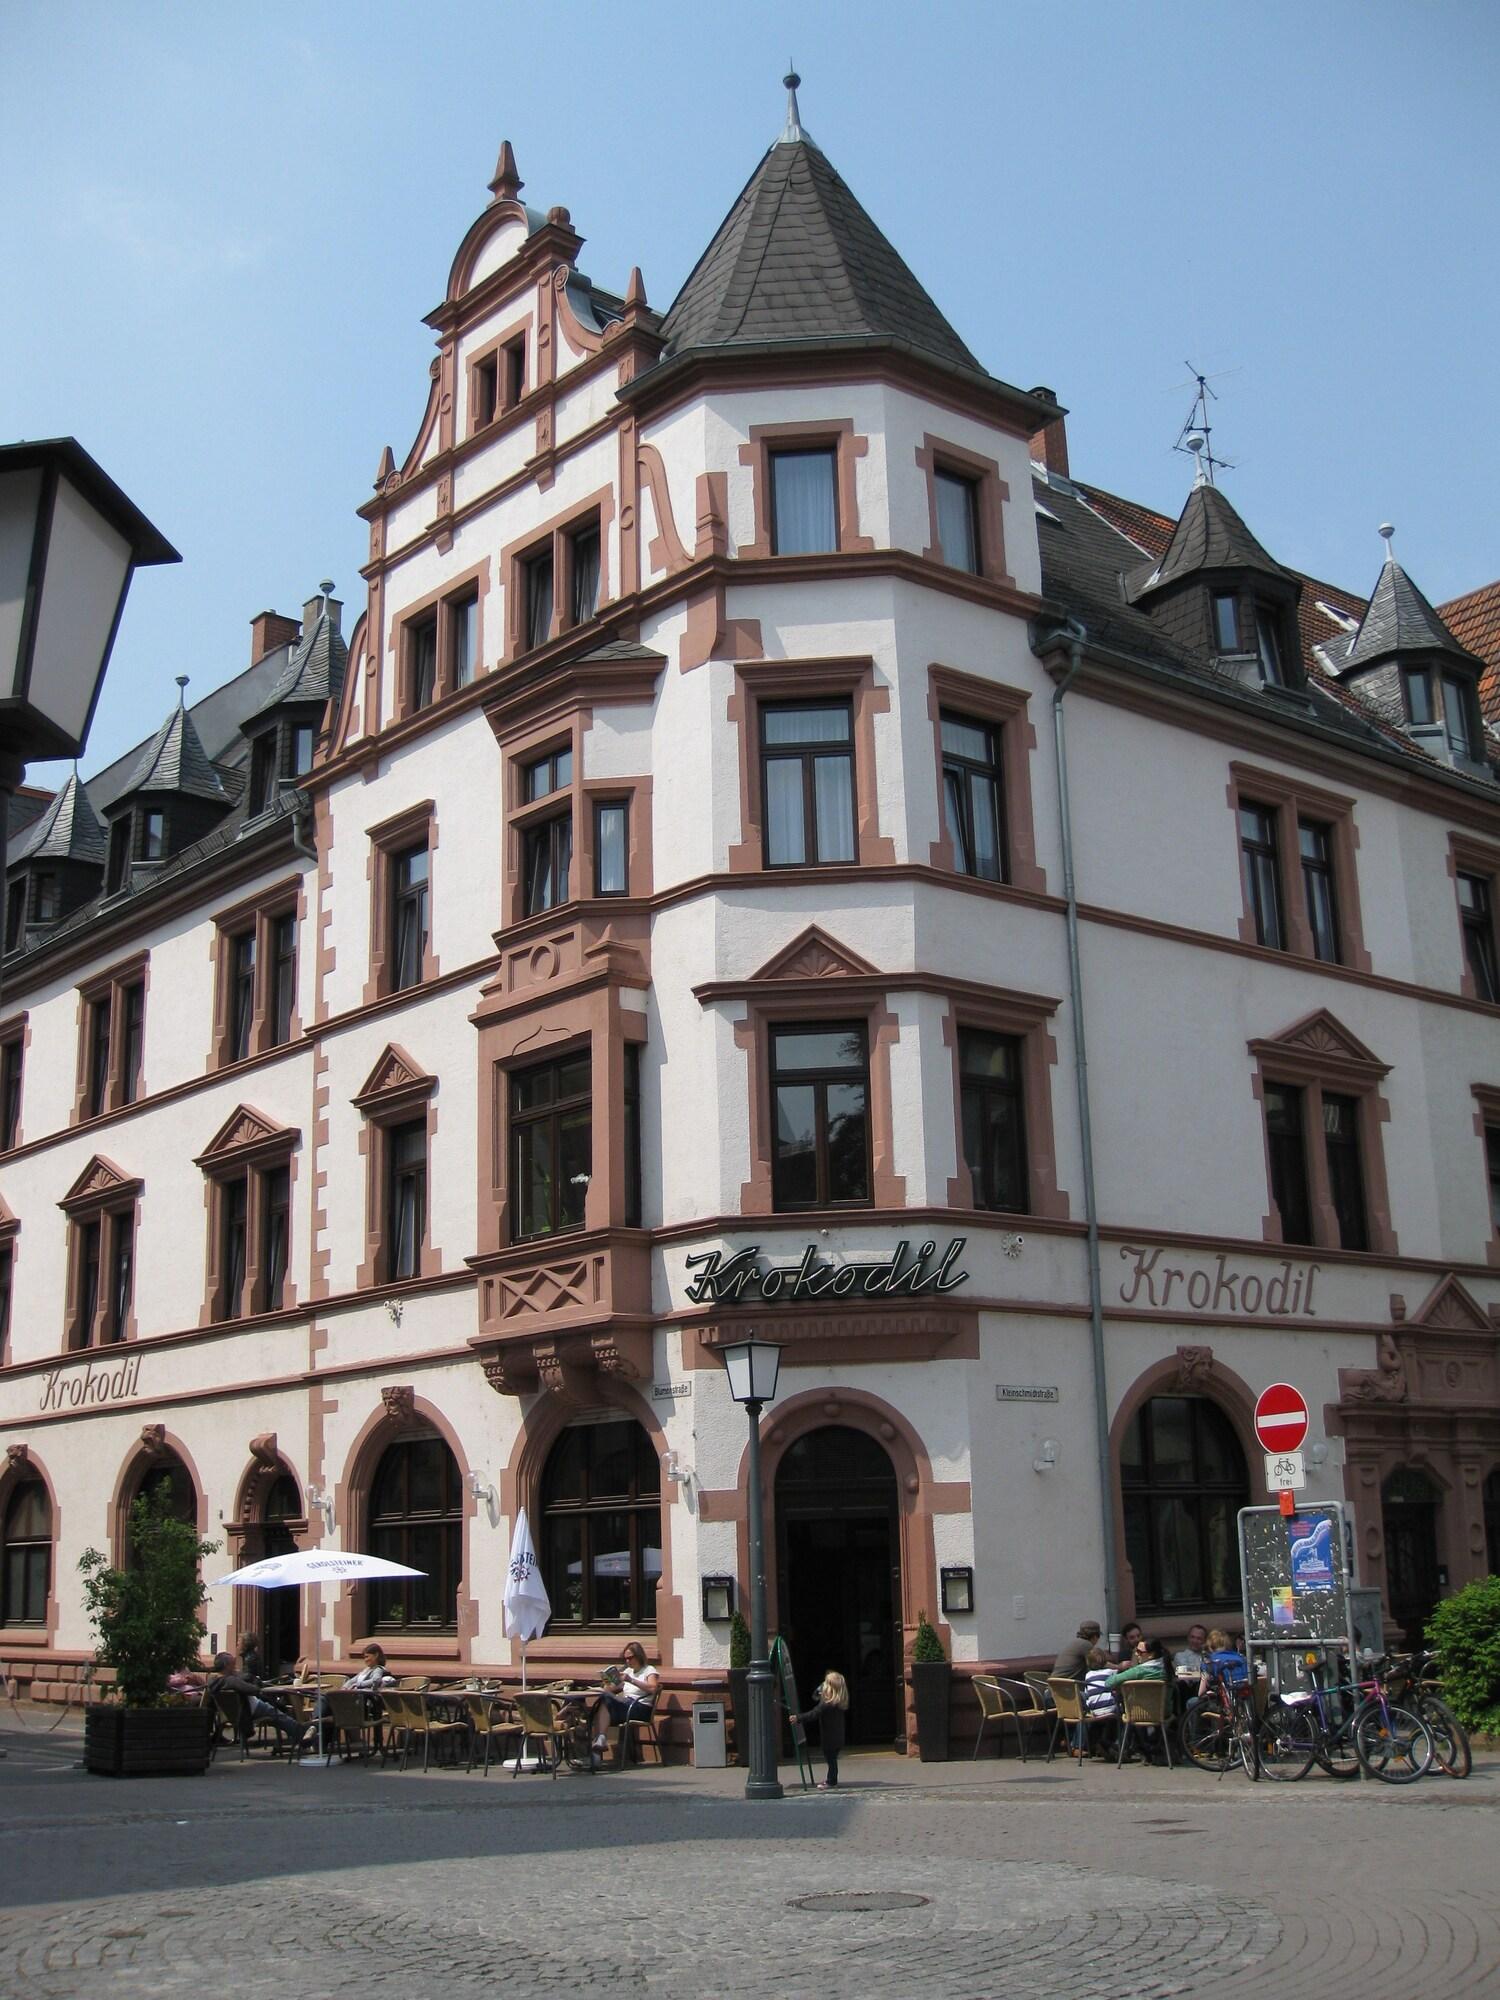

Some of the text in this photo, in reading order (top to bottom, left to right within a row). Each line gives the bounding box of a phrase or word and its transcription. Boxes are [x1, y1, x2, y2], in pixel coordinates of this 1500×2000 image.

[684, 1237, 970, 1303] Krokodil
[1119, 1245, 1321, 1316] Krokodil
[40, 1353, 144, 1411] Krokodil
[654, 1384, 688, 1397] Blumenstraße
[1279, 1478, 1293, 1487] frei
